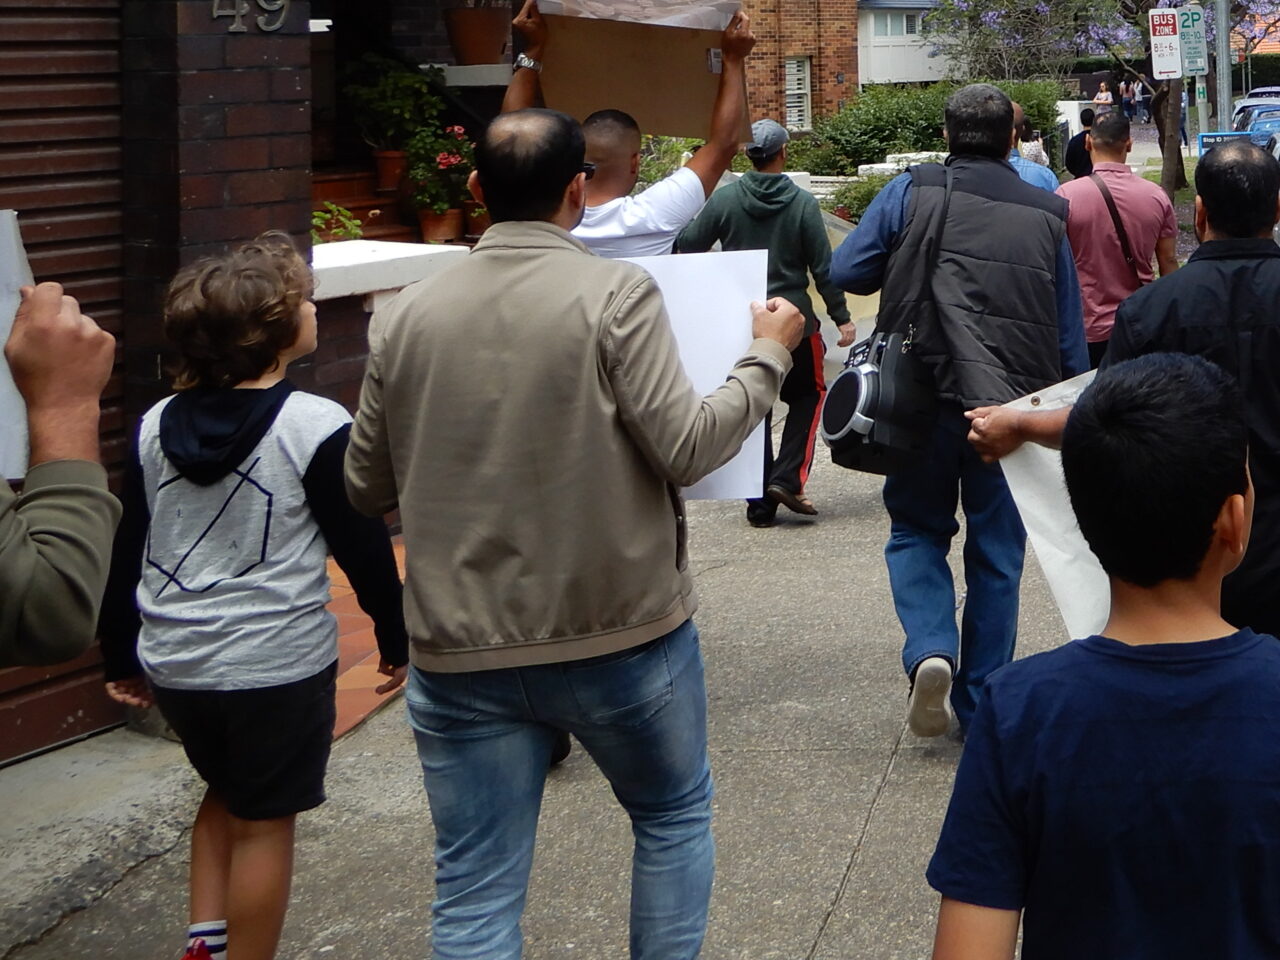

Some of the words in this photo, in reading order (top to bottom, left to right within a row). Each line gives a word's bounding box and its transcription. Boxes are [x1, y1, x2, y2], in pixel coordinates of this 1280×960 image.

[1153, 15, 1174, 25] BUS
[1180, 12, 1201, 28] 2P
[1155, 25, 1174, 36] ZONE
[1198, 87, 1206, 99] H
